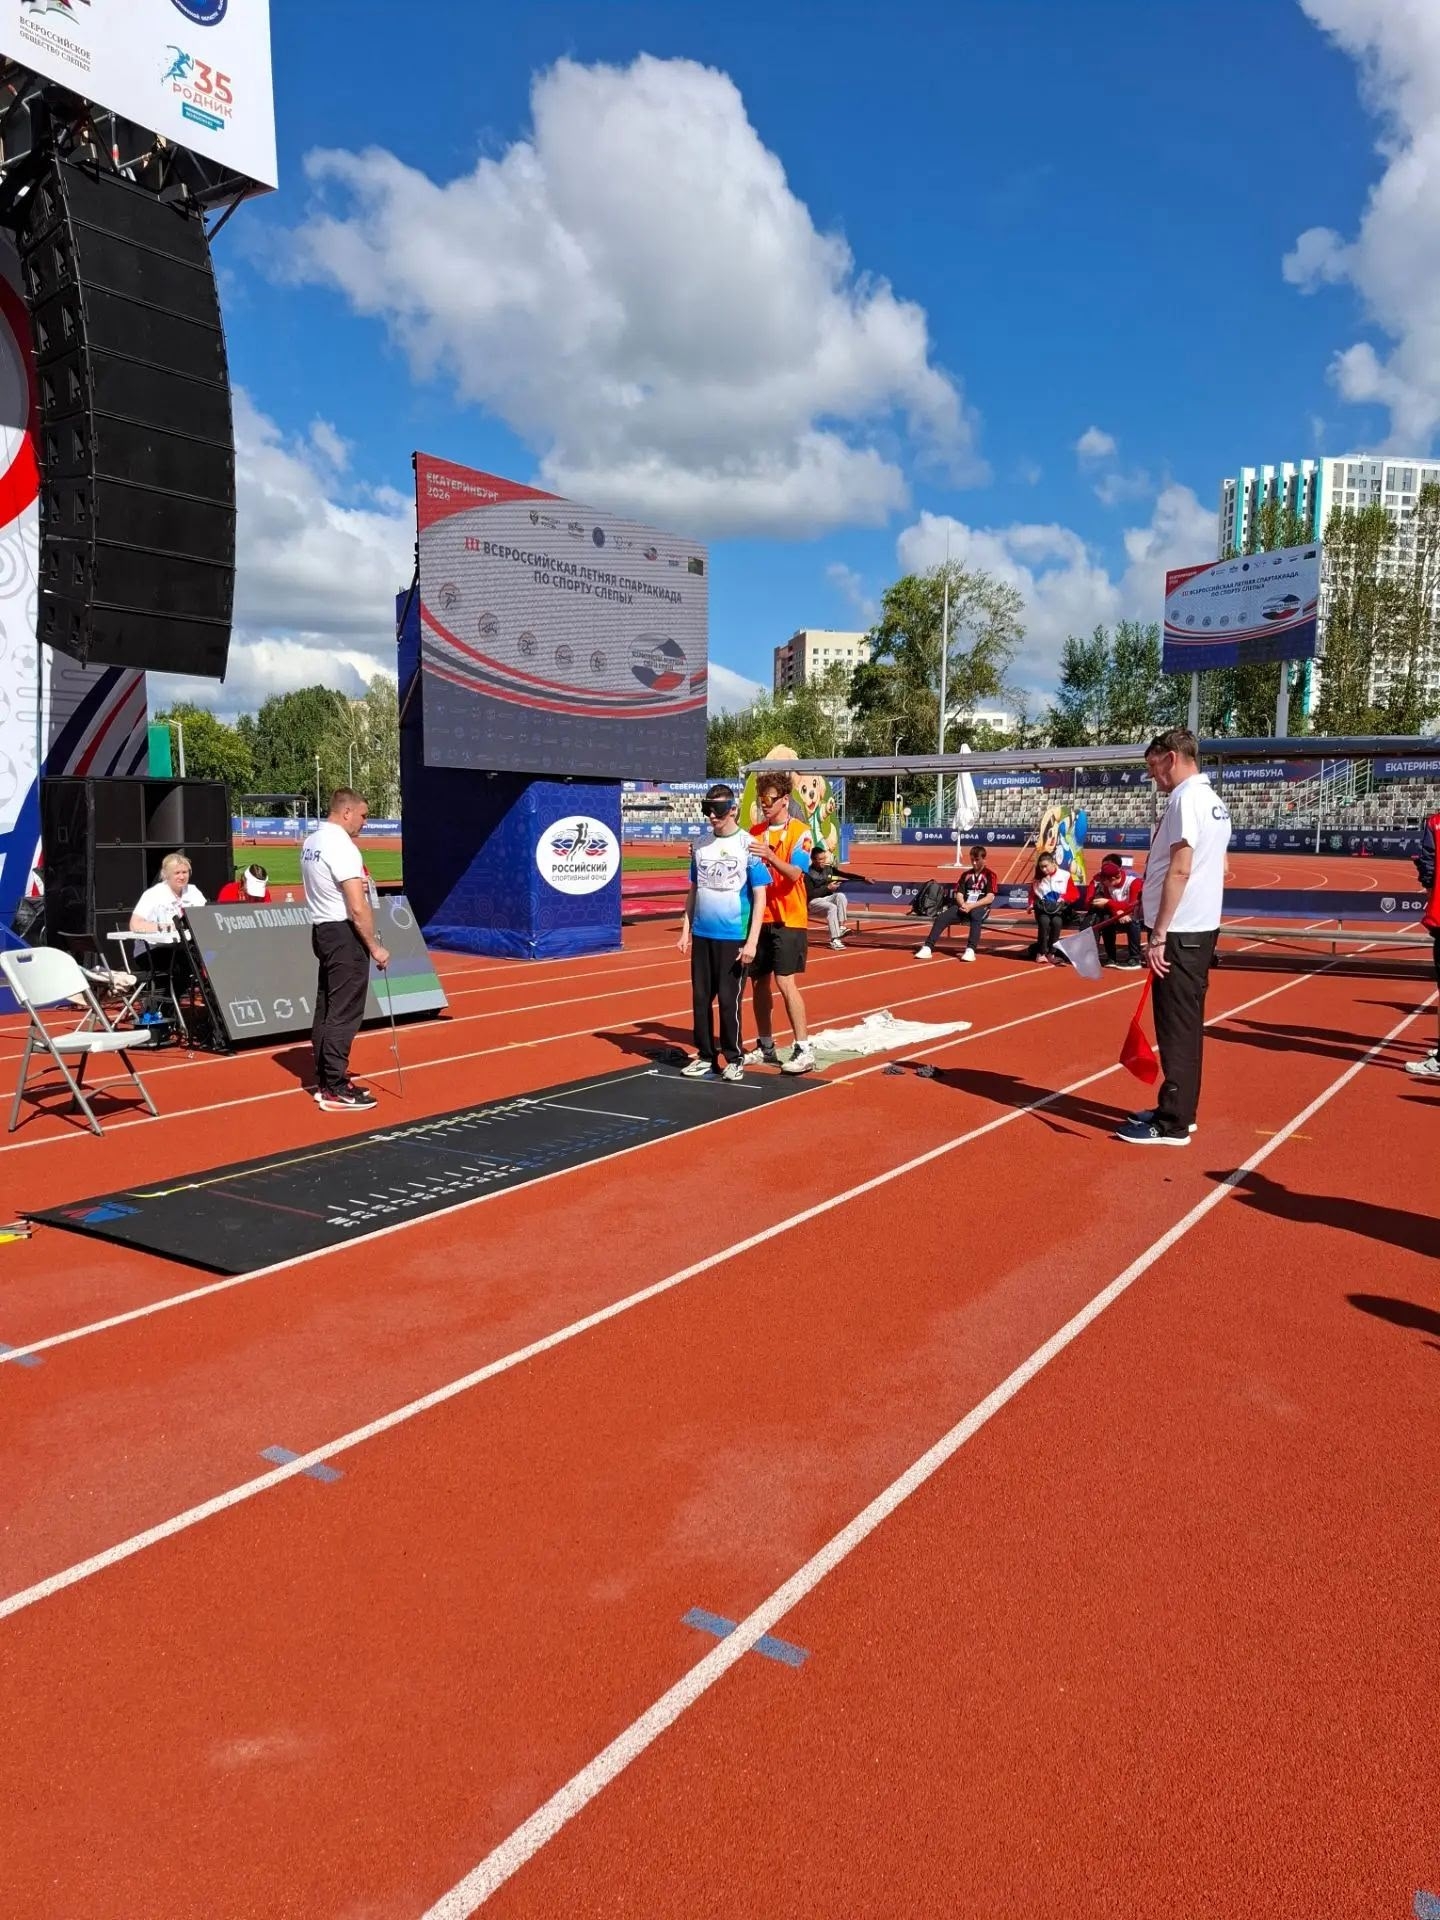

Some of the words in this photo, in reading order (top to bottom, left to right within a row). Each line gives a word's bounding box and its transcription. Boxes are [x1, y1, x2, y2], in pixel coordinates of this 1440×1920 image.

[19, 16, 91, 60] ВСЕРОССИЙСКОЕ
[20, 30, 60, 56] ОБЩЕСТВО
[61, 52, 91, 72] СЛЕПЫХ
[194, 59, 233, 104] 35
[172, 82, 232, 119] РОДНИК
[426, 472, 498, 501] ЕКАТЕРИНБУРГ
[427, 486, 451, 500] 2026
[464, 536, 481, 552] III
[483, 541, 577, 576] ВСЕРОССИЙСКАЯ
[580, 566, 617, 589] ЛЕТНЯЯ
[619, 577, 682, 604] СПАРТАКИАДА
[534, 570, 549, 584] ПО
[552, 575, 592, 595] СПОРТУ
[595, 586, 633, 605] СЛЕПЫХ
[983, 776, 1041, 786] EKATERINBURG
[1242, 768, 1283, 778] ТРИБУНА
[551, 862, 608, 873] РОССИЙСКИЙ
[551, 874, 590, 882] СПОРТИВНЫЙ
[591, 873, 607, 881] ФОНД
[710, 868, 723, 878] 74
[214, 912, 256, 934] Руслан
[237, 1005, 256, 1020] 74
[299, 996, 311, 1014] 1
